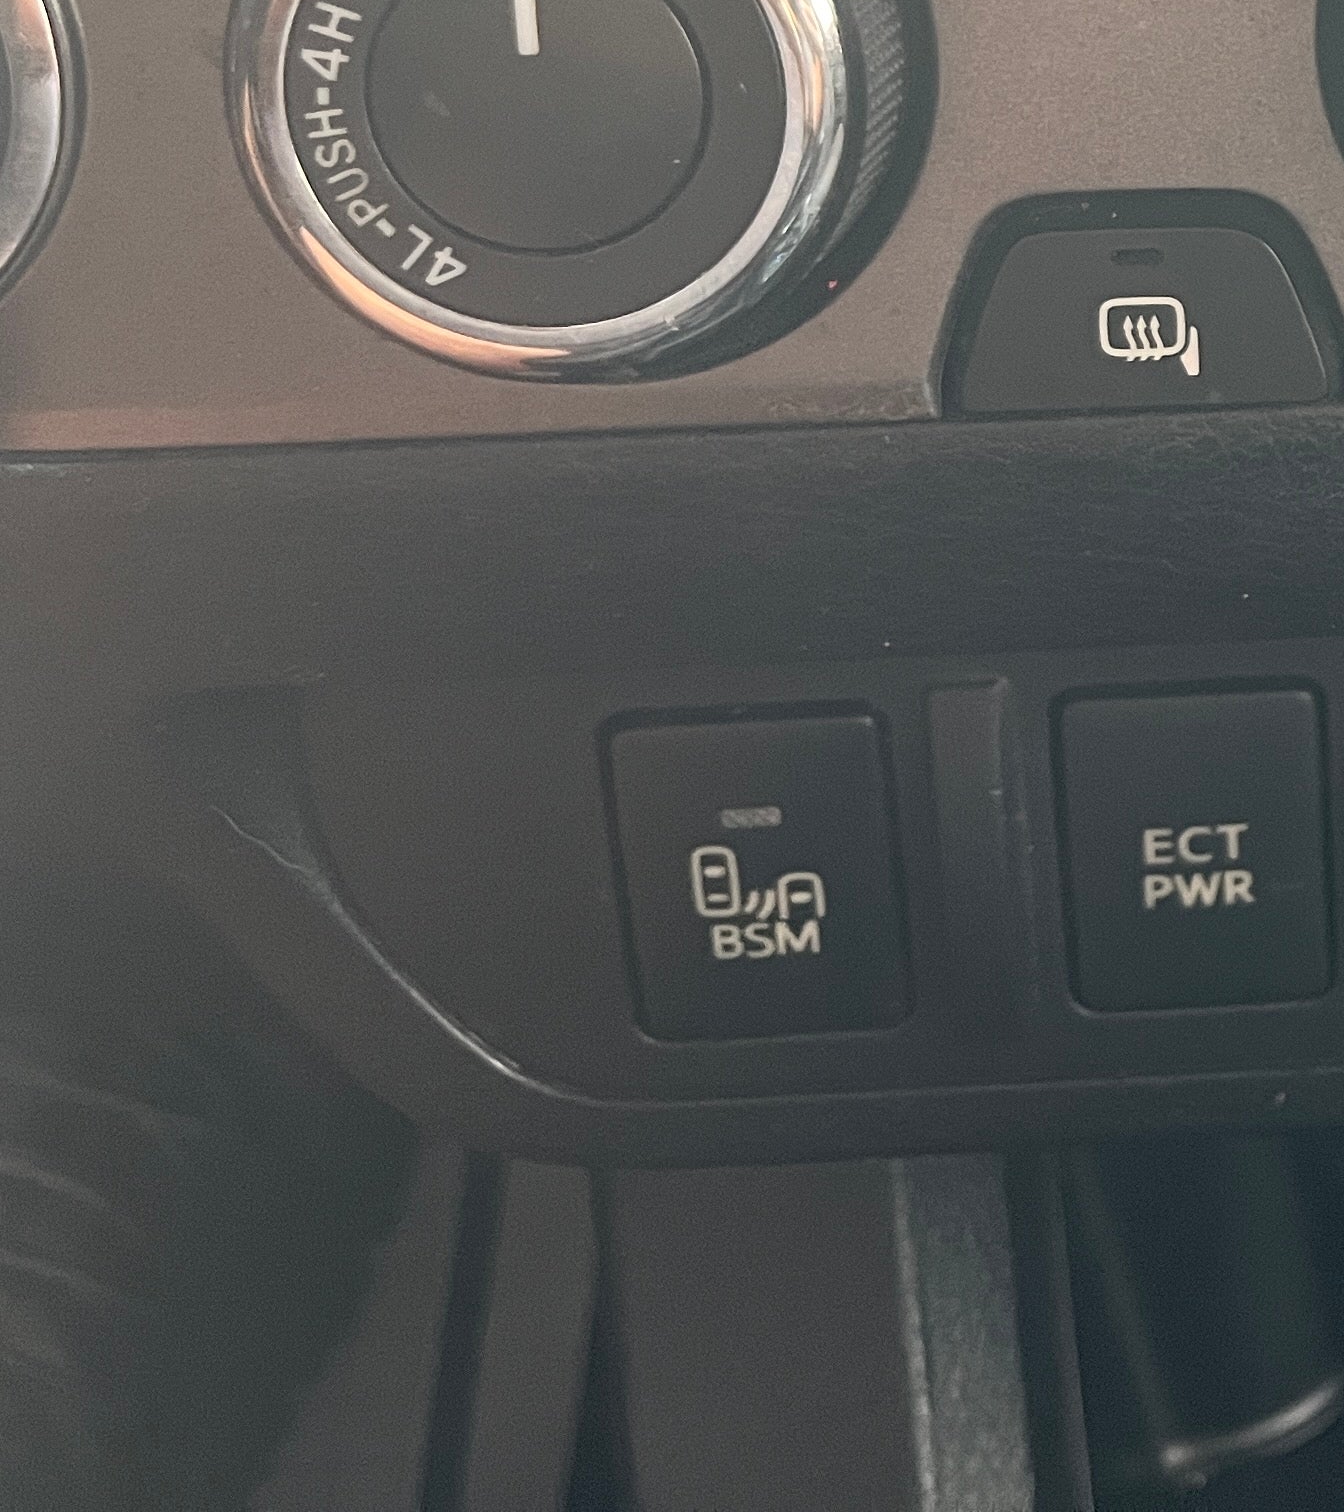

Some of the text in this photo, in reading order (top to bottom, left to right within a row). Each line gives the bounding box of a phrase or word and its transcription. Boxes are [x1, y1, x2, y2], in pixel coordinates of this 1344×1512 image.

[1141, 823, 1249, 866] ECT
[1141, 870, 1255, 910] PWR
[711, 918, 822, 960] BSM
